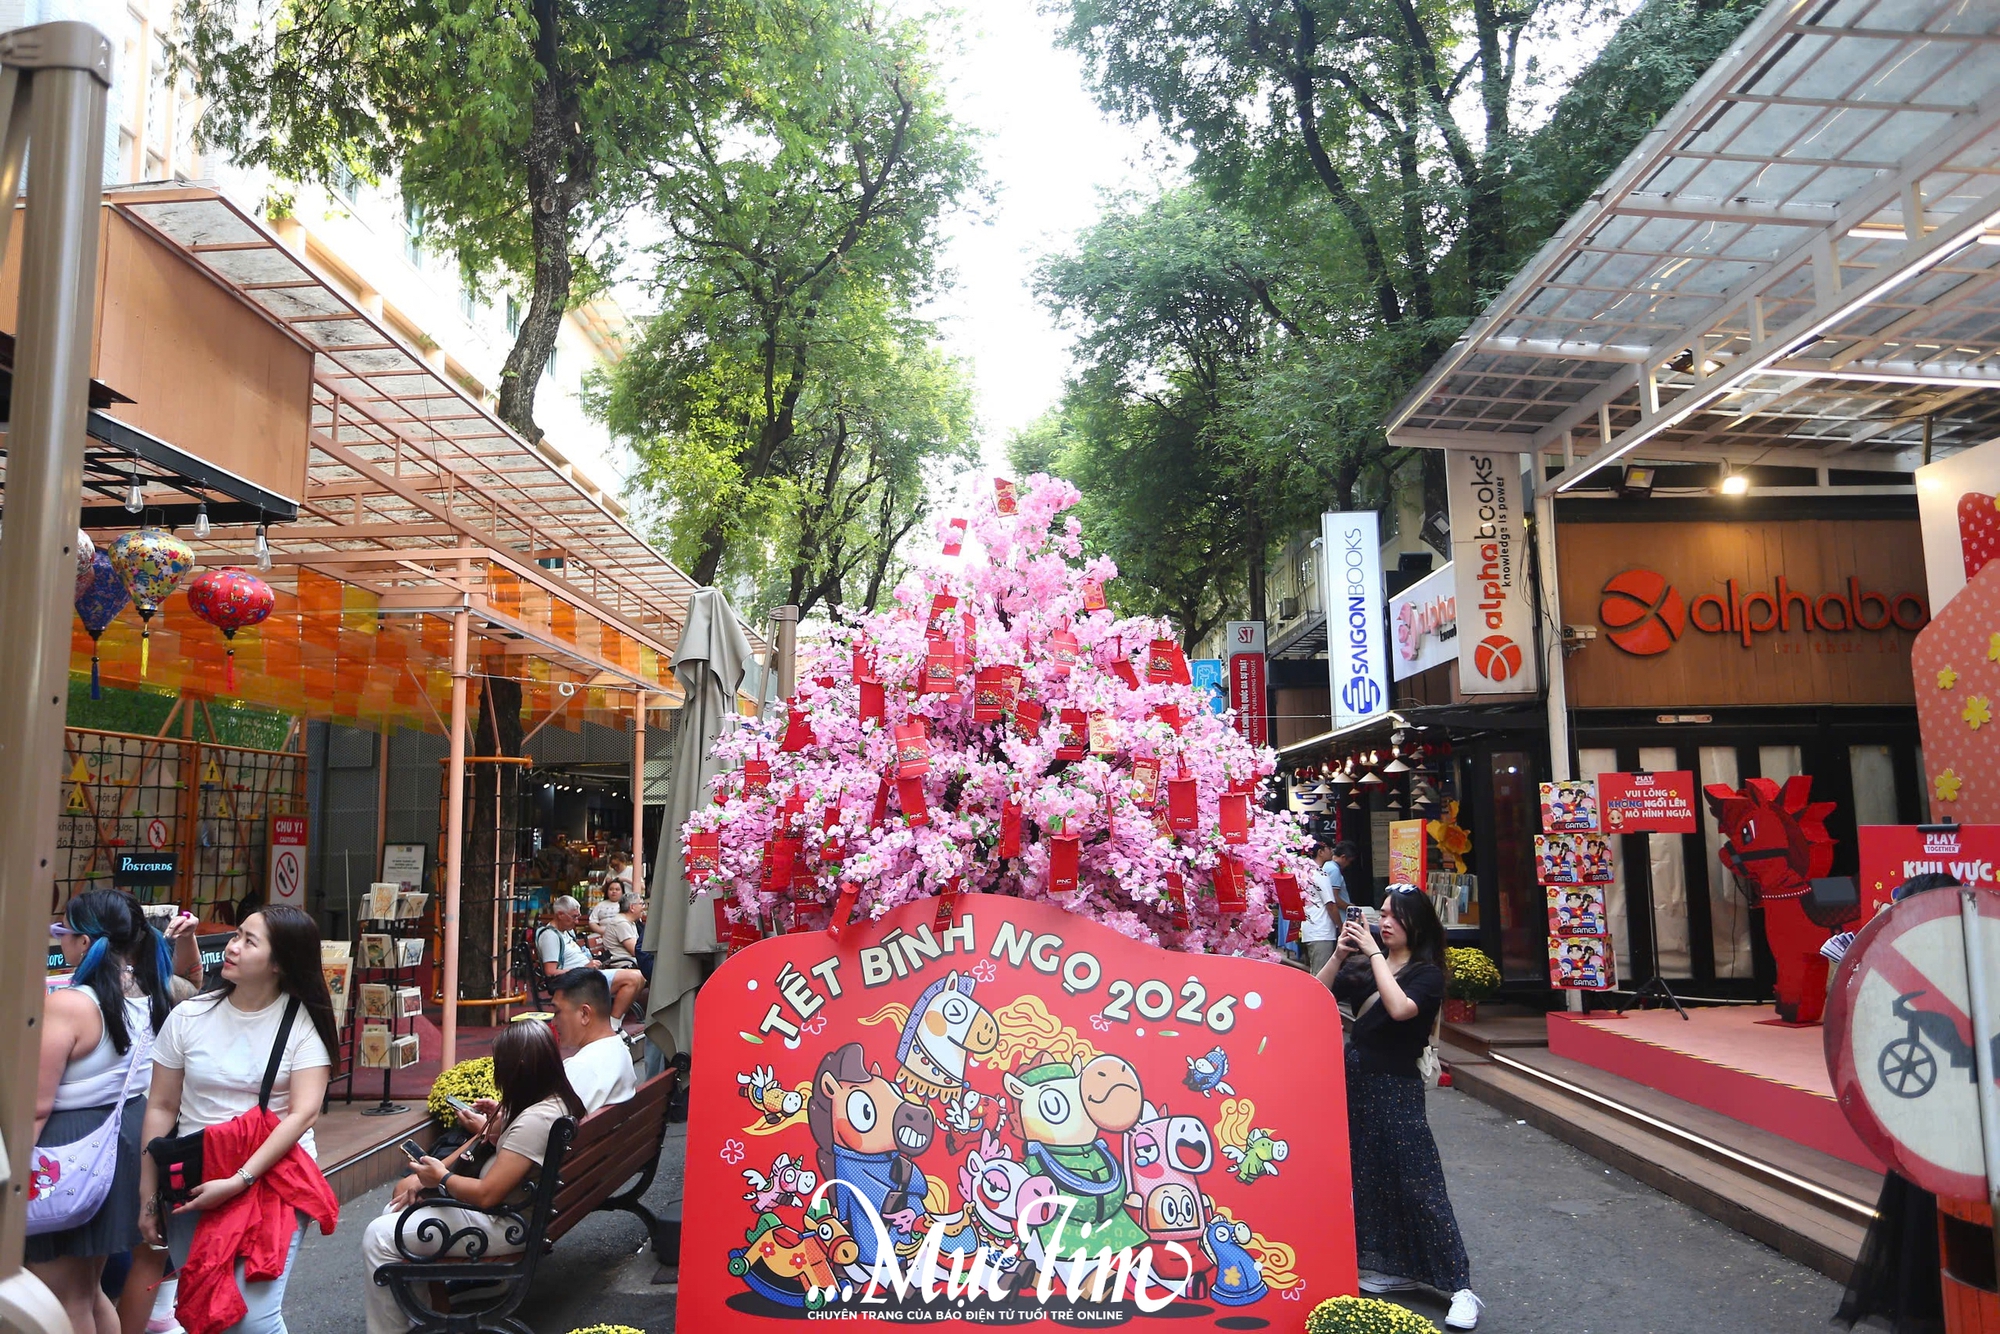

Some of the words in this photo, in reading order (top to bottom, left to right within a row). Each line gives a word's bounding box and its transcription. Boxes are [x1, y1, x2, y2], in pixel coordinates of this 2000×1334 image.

[1496, 477, 1508, 511] power
[1498, 514, 1507, 523] is
[1470, 455, 1506, 630] alphabooks
[1498, 526, 1511, 587] knowledge
[1344, 528, 1369, 674] SAIGONBOOKS
[1238, 627, 1254, 643] ST
[1643, 788, 1668, 797] LÒNG
[1608, 798, 1642, 808] KHÔNG
[1669, 797, 1686, 807] LÊN
[1625, 808, 1640, 818] MÔ
[1642, 809, 1664, 818] HÌNH
[1666, 808, 1692, 819] NGỰA
[276, 819, 292, 833] CHÚ
[279, 836, 298, 844] CAUTION
[1926, 834, 1956, 844] PLAY
[1949, 859, 1993, 886] VỰC
[759, 956, 843, 1041] TẾT
[859, 914, 975, 988] BÍNH
[989, 920, 1101, 994] NGỌ
[1102, 979, 1238, 1033] 2026
